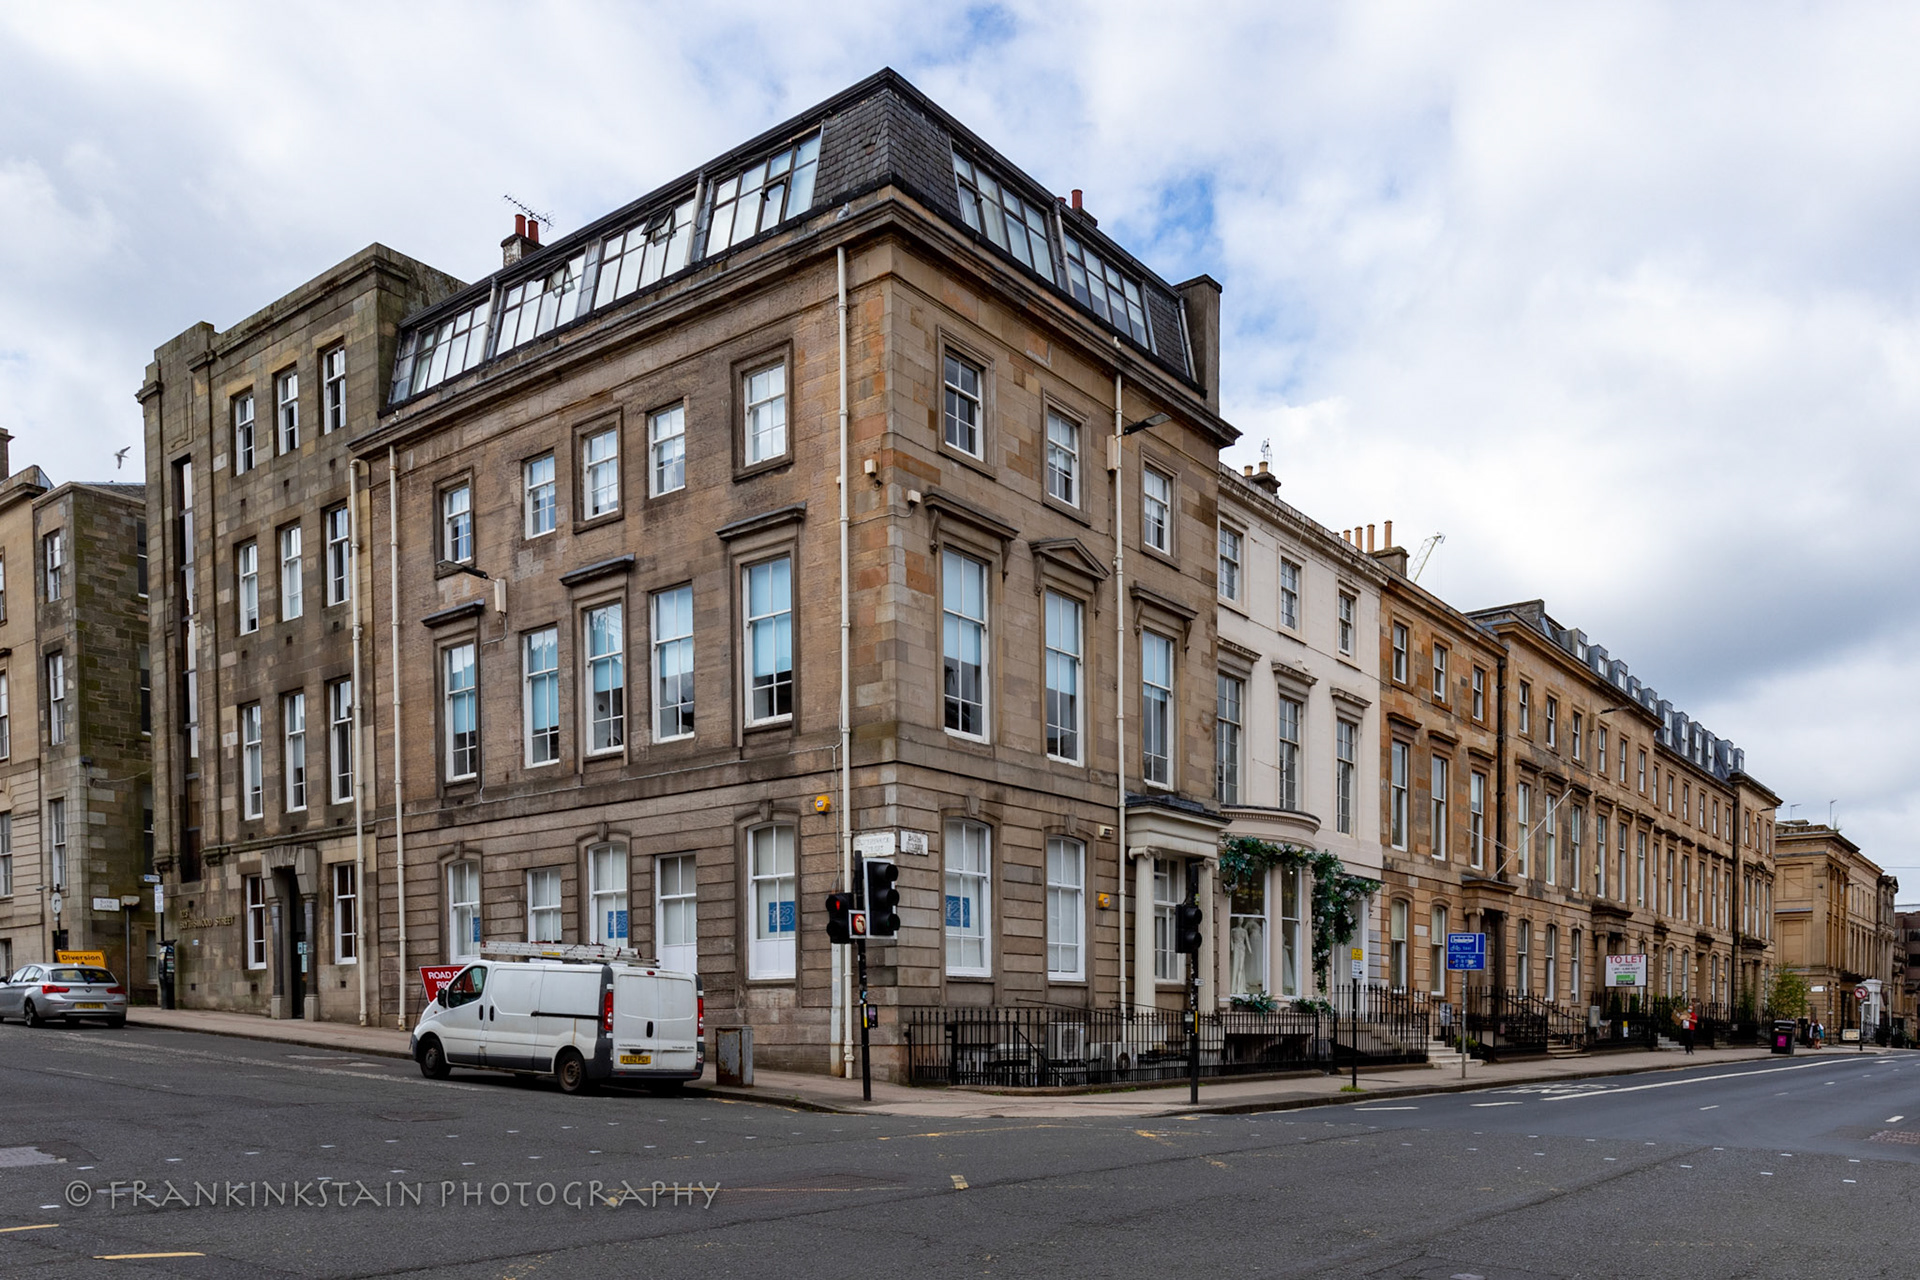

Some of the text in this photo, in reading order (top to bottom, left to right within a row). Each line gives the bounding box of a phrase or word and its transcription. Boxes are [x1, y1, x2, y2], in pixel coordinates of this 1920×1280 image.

[215, 916, 235, 926] STREET
[1609, 954, 1643, 964] TO LET
[428, 971, 452, 979] ROAD
